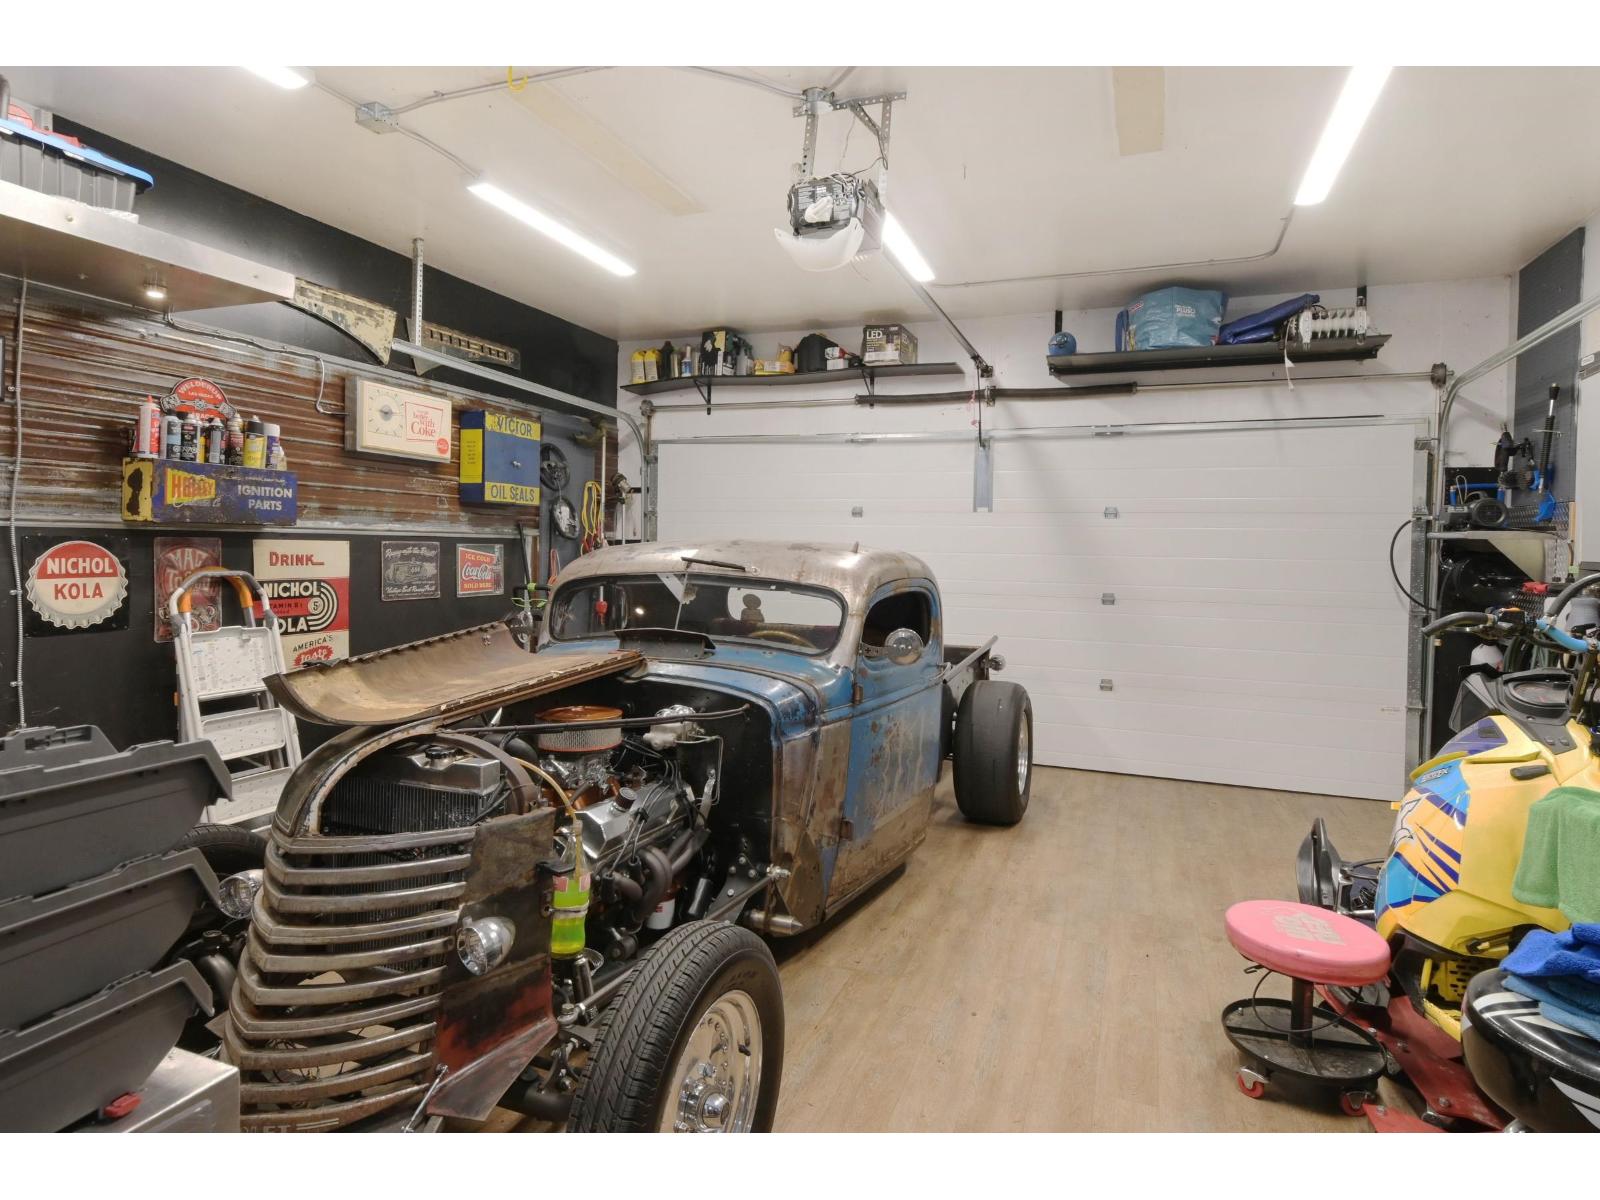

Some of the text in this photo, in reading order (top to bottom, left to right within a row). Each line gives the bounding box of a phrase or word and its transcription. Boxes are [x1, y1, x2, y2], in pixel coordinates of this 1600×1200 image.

[866, 330, 883, 340] LED
[411, 421, 436, 437] Coke
[497, 414, 533, 437] VICTOR
[237, 484, 293, 499] IGNITION
[490, 484, 535, 502] OIL SEALS
[248, 499, 282, 511] PARTS
[46, 557, 114, 575] NICHOL
[269, 551, 324, 567] DRINK
[54, 583, 104, 600] KOLA
[263, 581, 321, 598] NICHOL
[293, 634, 333, 653] AMERICA'S
